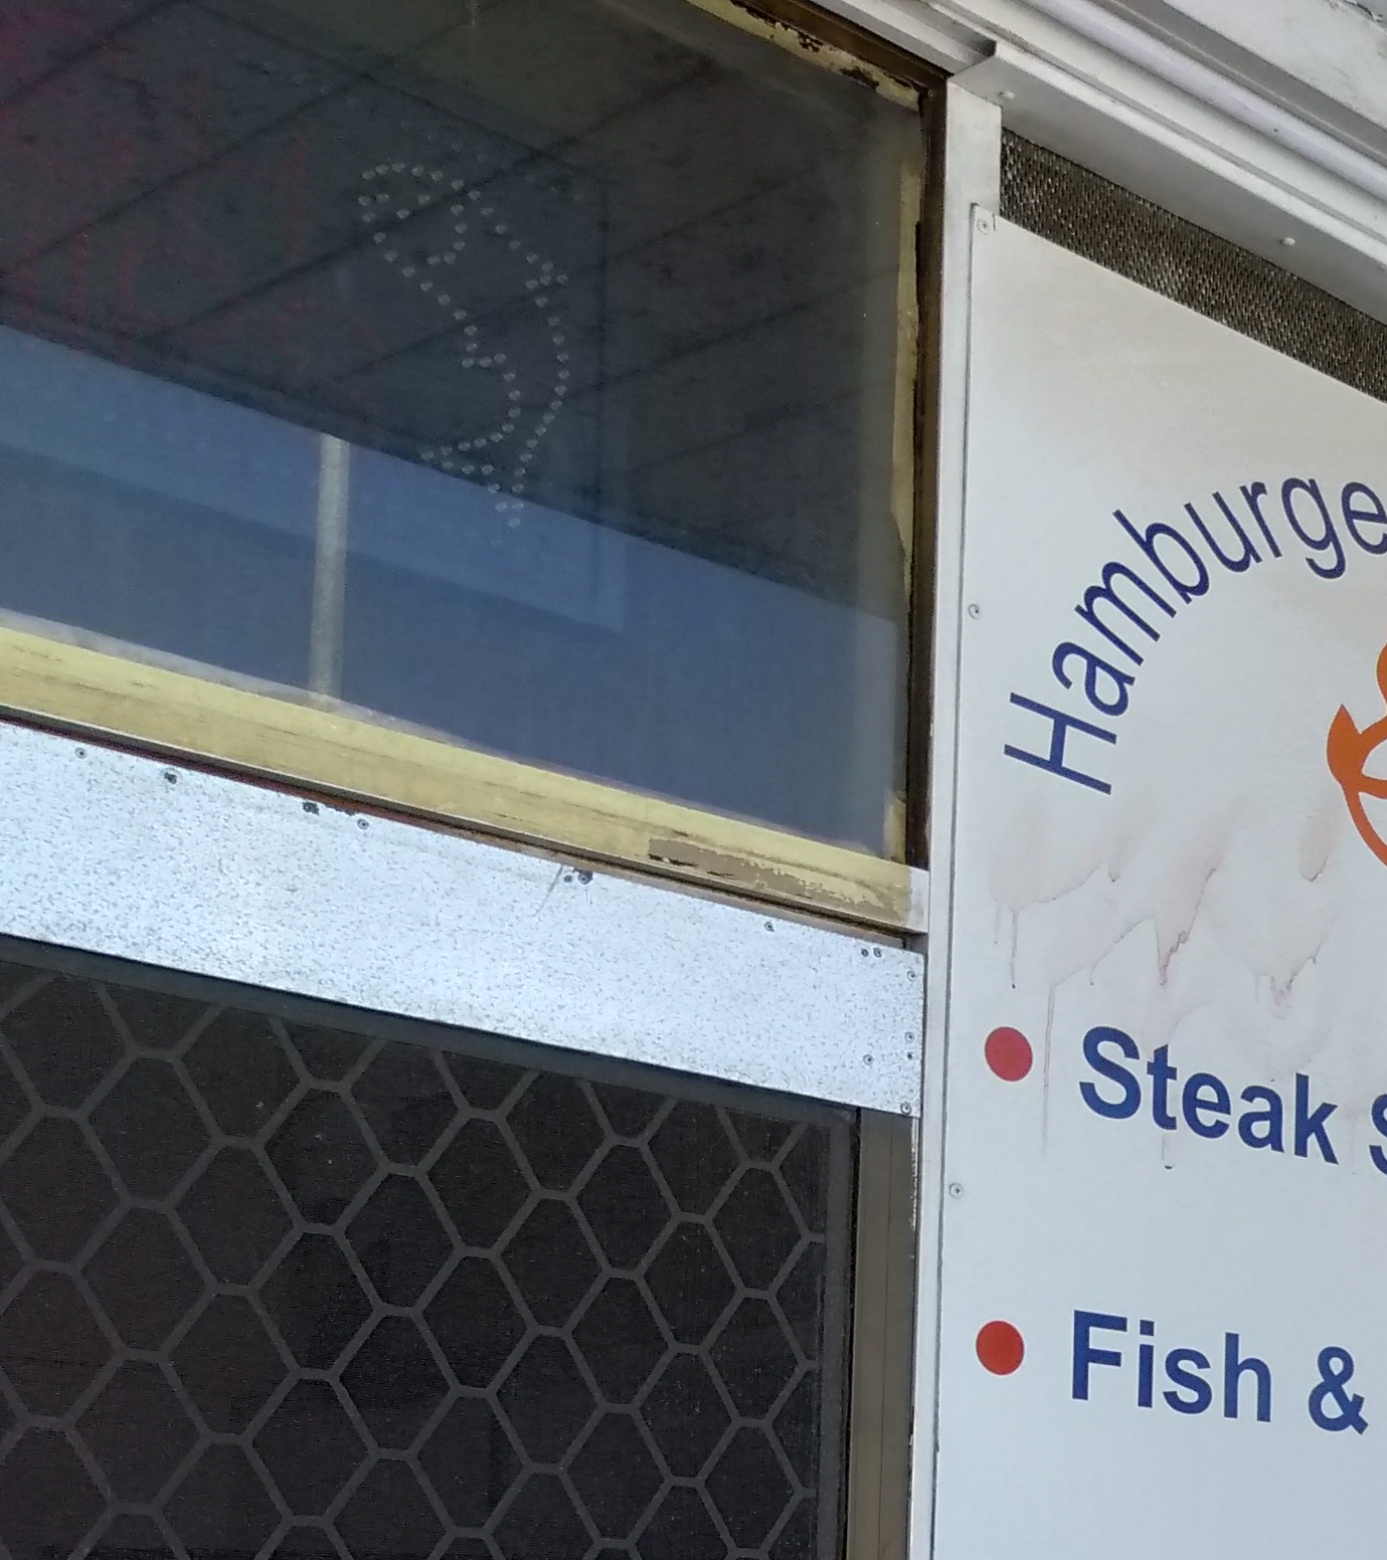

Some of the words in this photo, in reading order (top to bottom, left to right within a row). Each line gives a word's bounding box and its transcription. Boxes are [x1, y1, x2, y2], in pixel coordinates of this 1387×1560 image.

[1079, 1027, 1338, 1164] Steak
[1072, 1310, 1271, 1422] Fish
[1308, 1347, 1368, 1435] &
